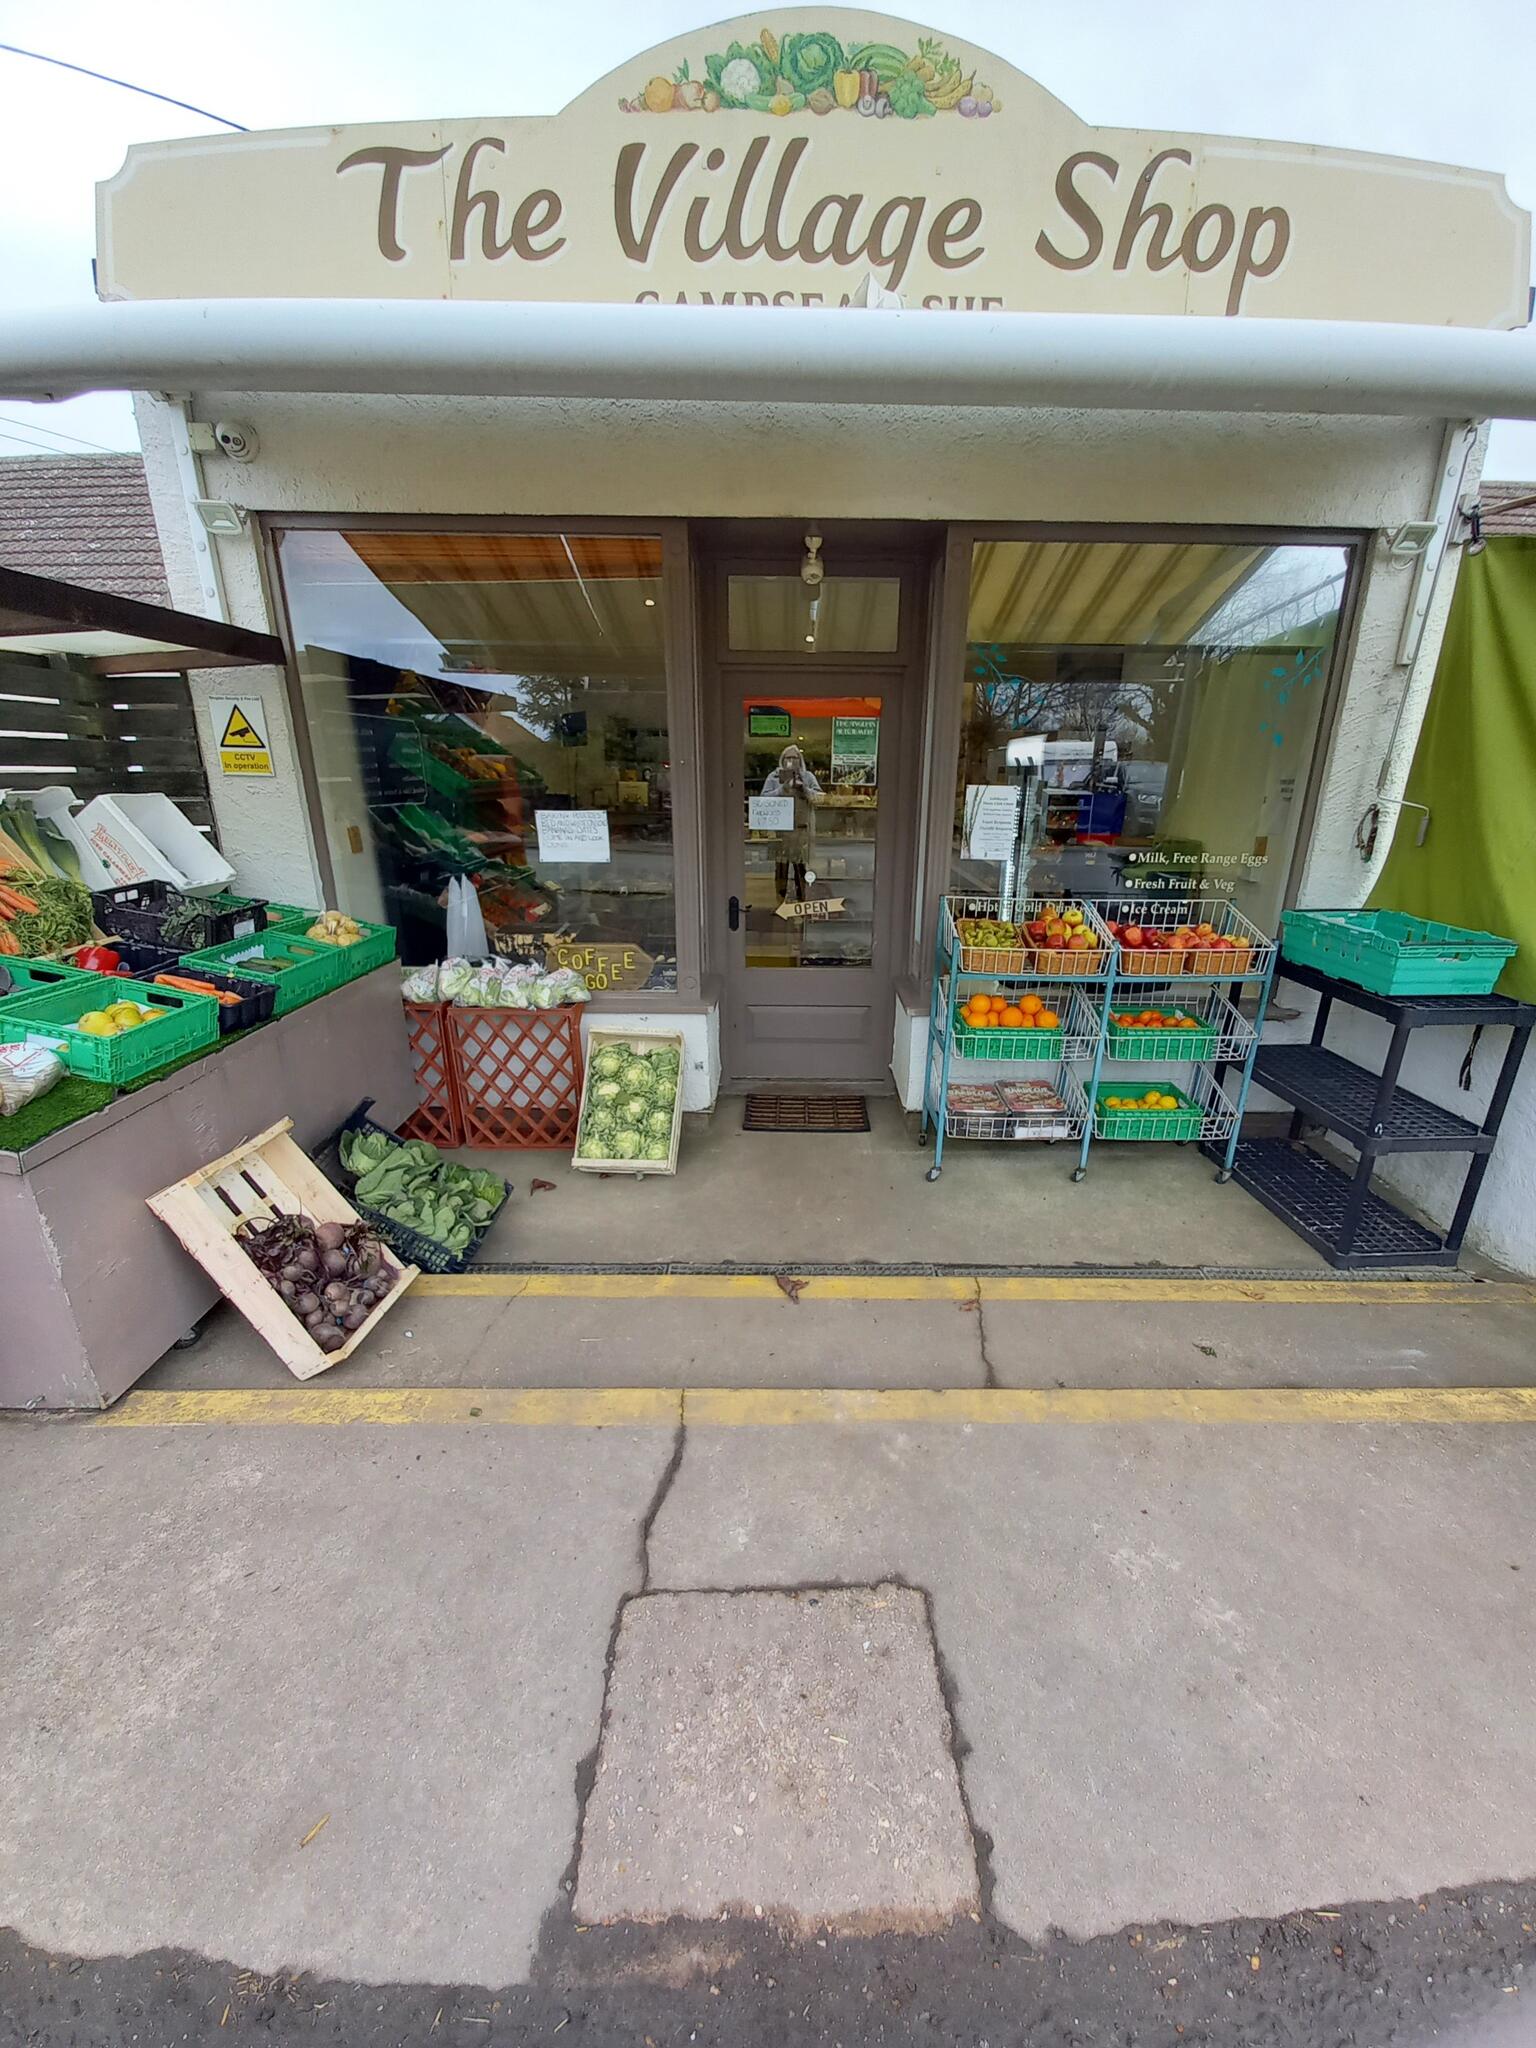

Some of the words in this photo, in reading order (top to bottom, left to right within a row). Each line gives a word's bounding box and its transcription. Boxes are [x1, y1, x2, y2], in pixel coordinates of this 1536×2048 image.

[337, 137, 567, 262] The
[614, 136, 985, 294] Village
[1035, 148, 1291, 316] Shop
[234, 753, 256, 761] CCTV
[233, 762, 270, 771] operation
[1137, 852, 1169, 865] Milk,
[1173, 853, 1198, 864] Free
[1201, 853, 1237, 867] Range
[1240, 853, 1269, 867] Eggs
[1133, 878, 1165, 890] Fresh
[1168, 878, 1196, 890] Fruit
[1199, 879, 1210, 890] &
[1213, 879, 1235, 893] Veg
[794, 901, 828, 915] OPEN
[976, 901, 999, 912] Hot
[1015, 901, 1042, 913] Cold
[1130, 903, 1148, 915] Ice
[1150, 903, 1188, 915] Cream
[558, 948, 636, 981] COFFEE
[586, 973, 608, 989] GO
